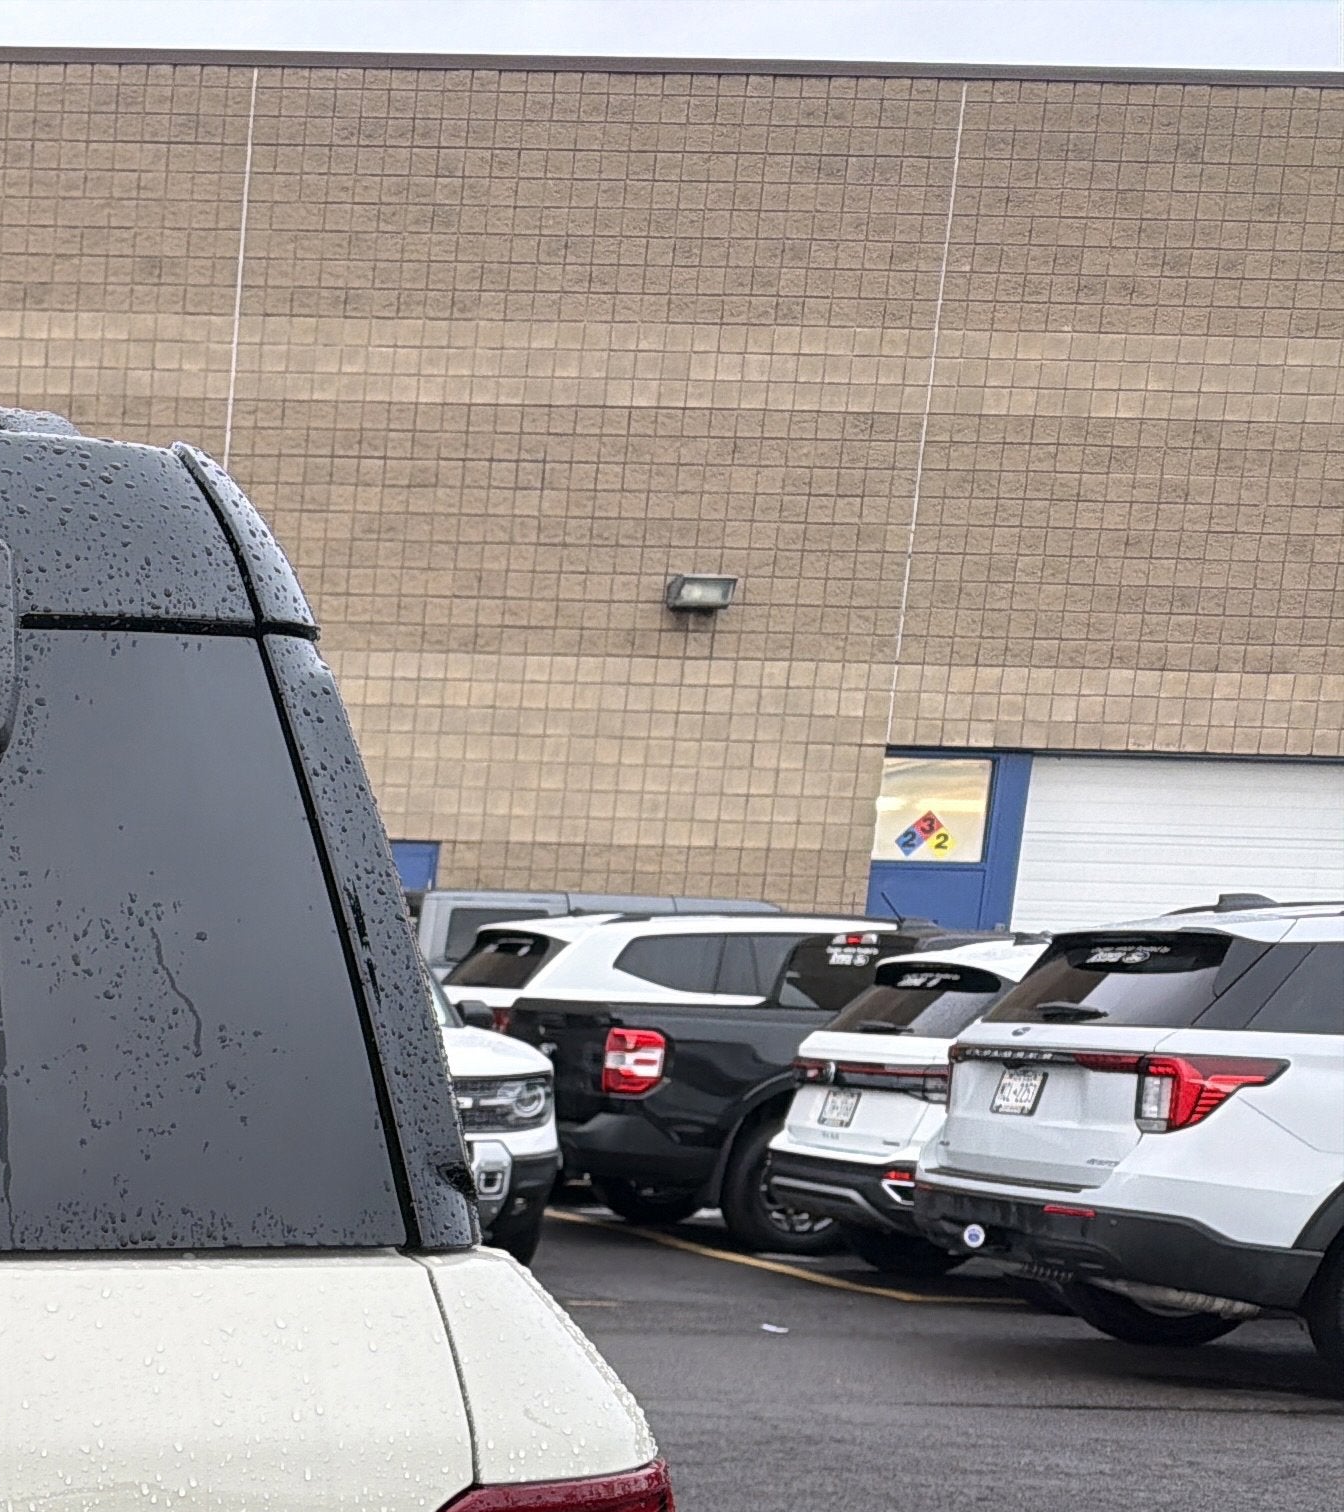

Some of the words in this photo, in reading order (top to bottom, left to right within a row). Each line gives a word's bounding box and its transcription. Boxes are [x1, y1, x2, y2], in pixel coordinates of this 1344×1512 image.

[920, 817, 936, 834] 3
[901, 831, 917, 848] 2
[934, 833, 949, 850] 2
